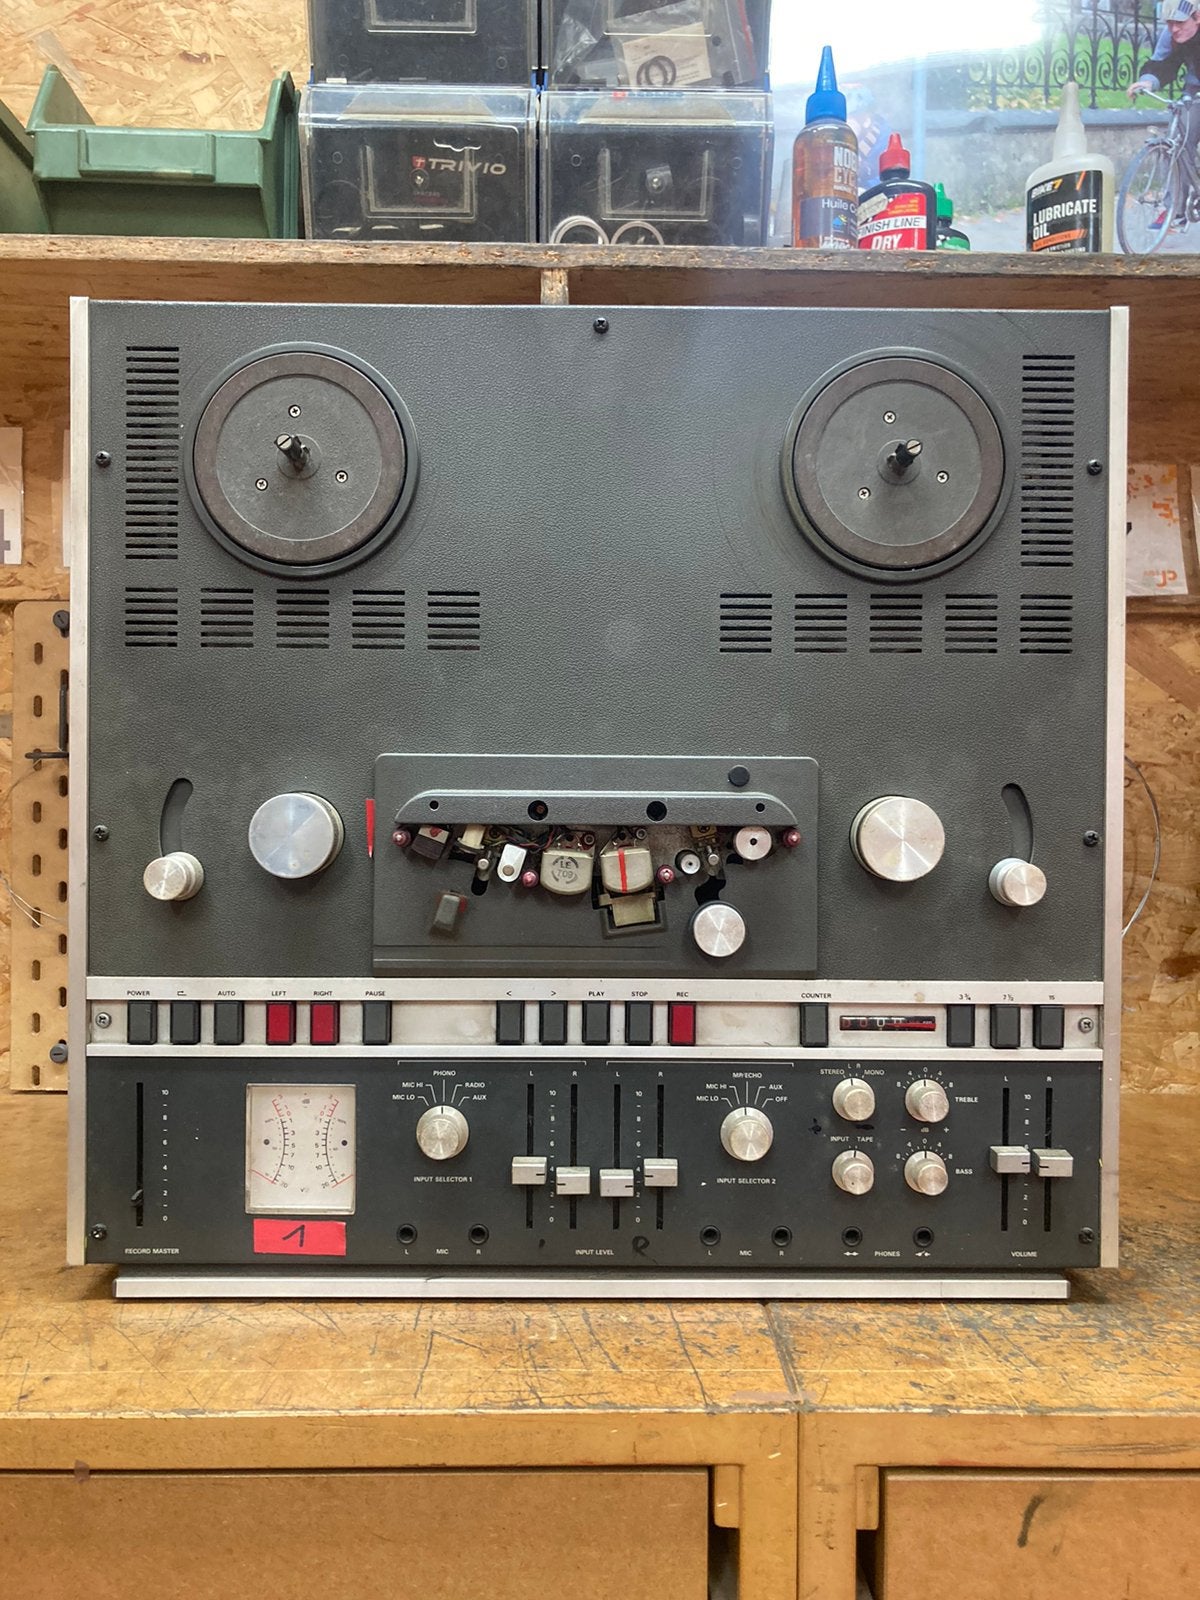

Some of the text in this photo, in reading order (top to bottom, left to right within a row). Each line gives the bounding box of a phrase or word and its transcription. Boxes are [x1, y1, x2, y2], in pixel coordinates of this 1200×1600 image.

[428, 158, 506, 175] TRIVIO
[822, 198, 848, 210] Huile
[1033, 199, 1097, 226] LUBRICATE
[894, 216, 921, 228] LINE
[1033, 223, 1050, 241] OIL
[872, 234, 903, 250] DRY
